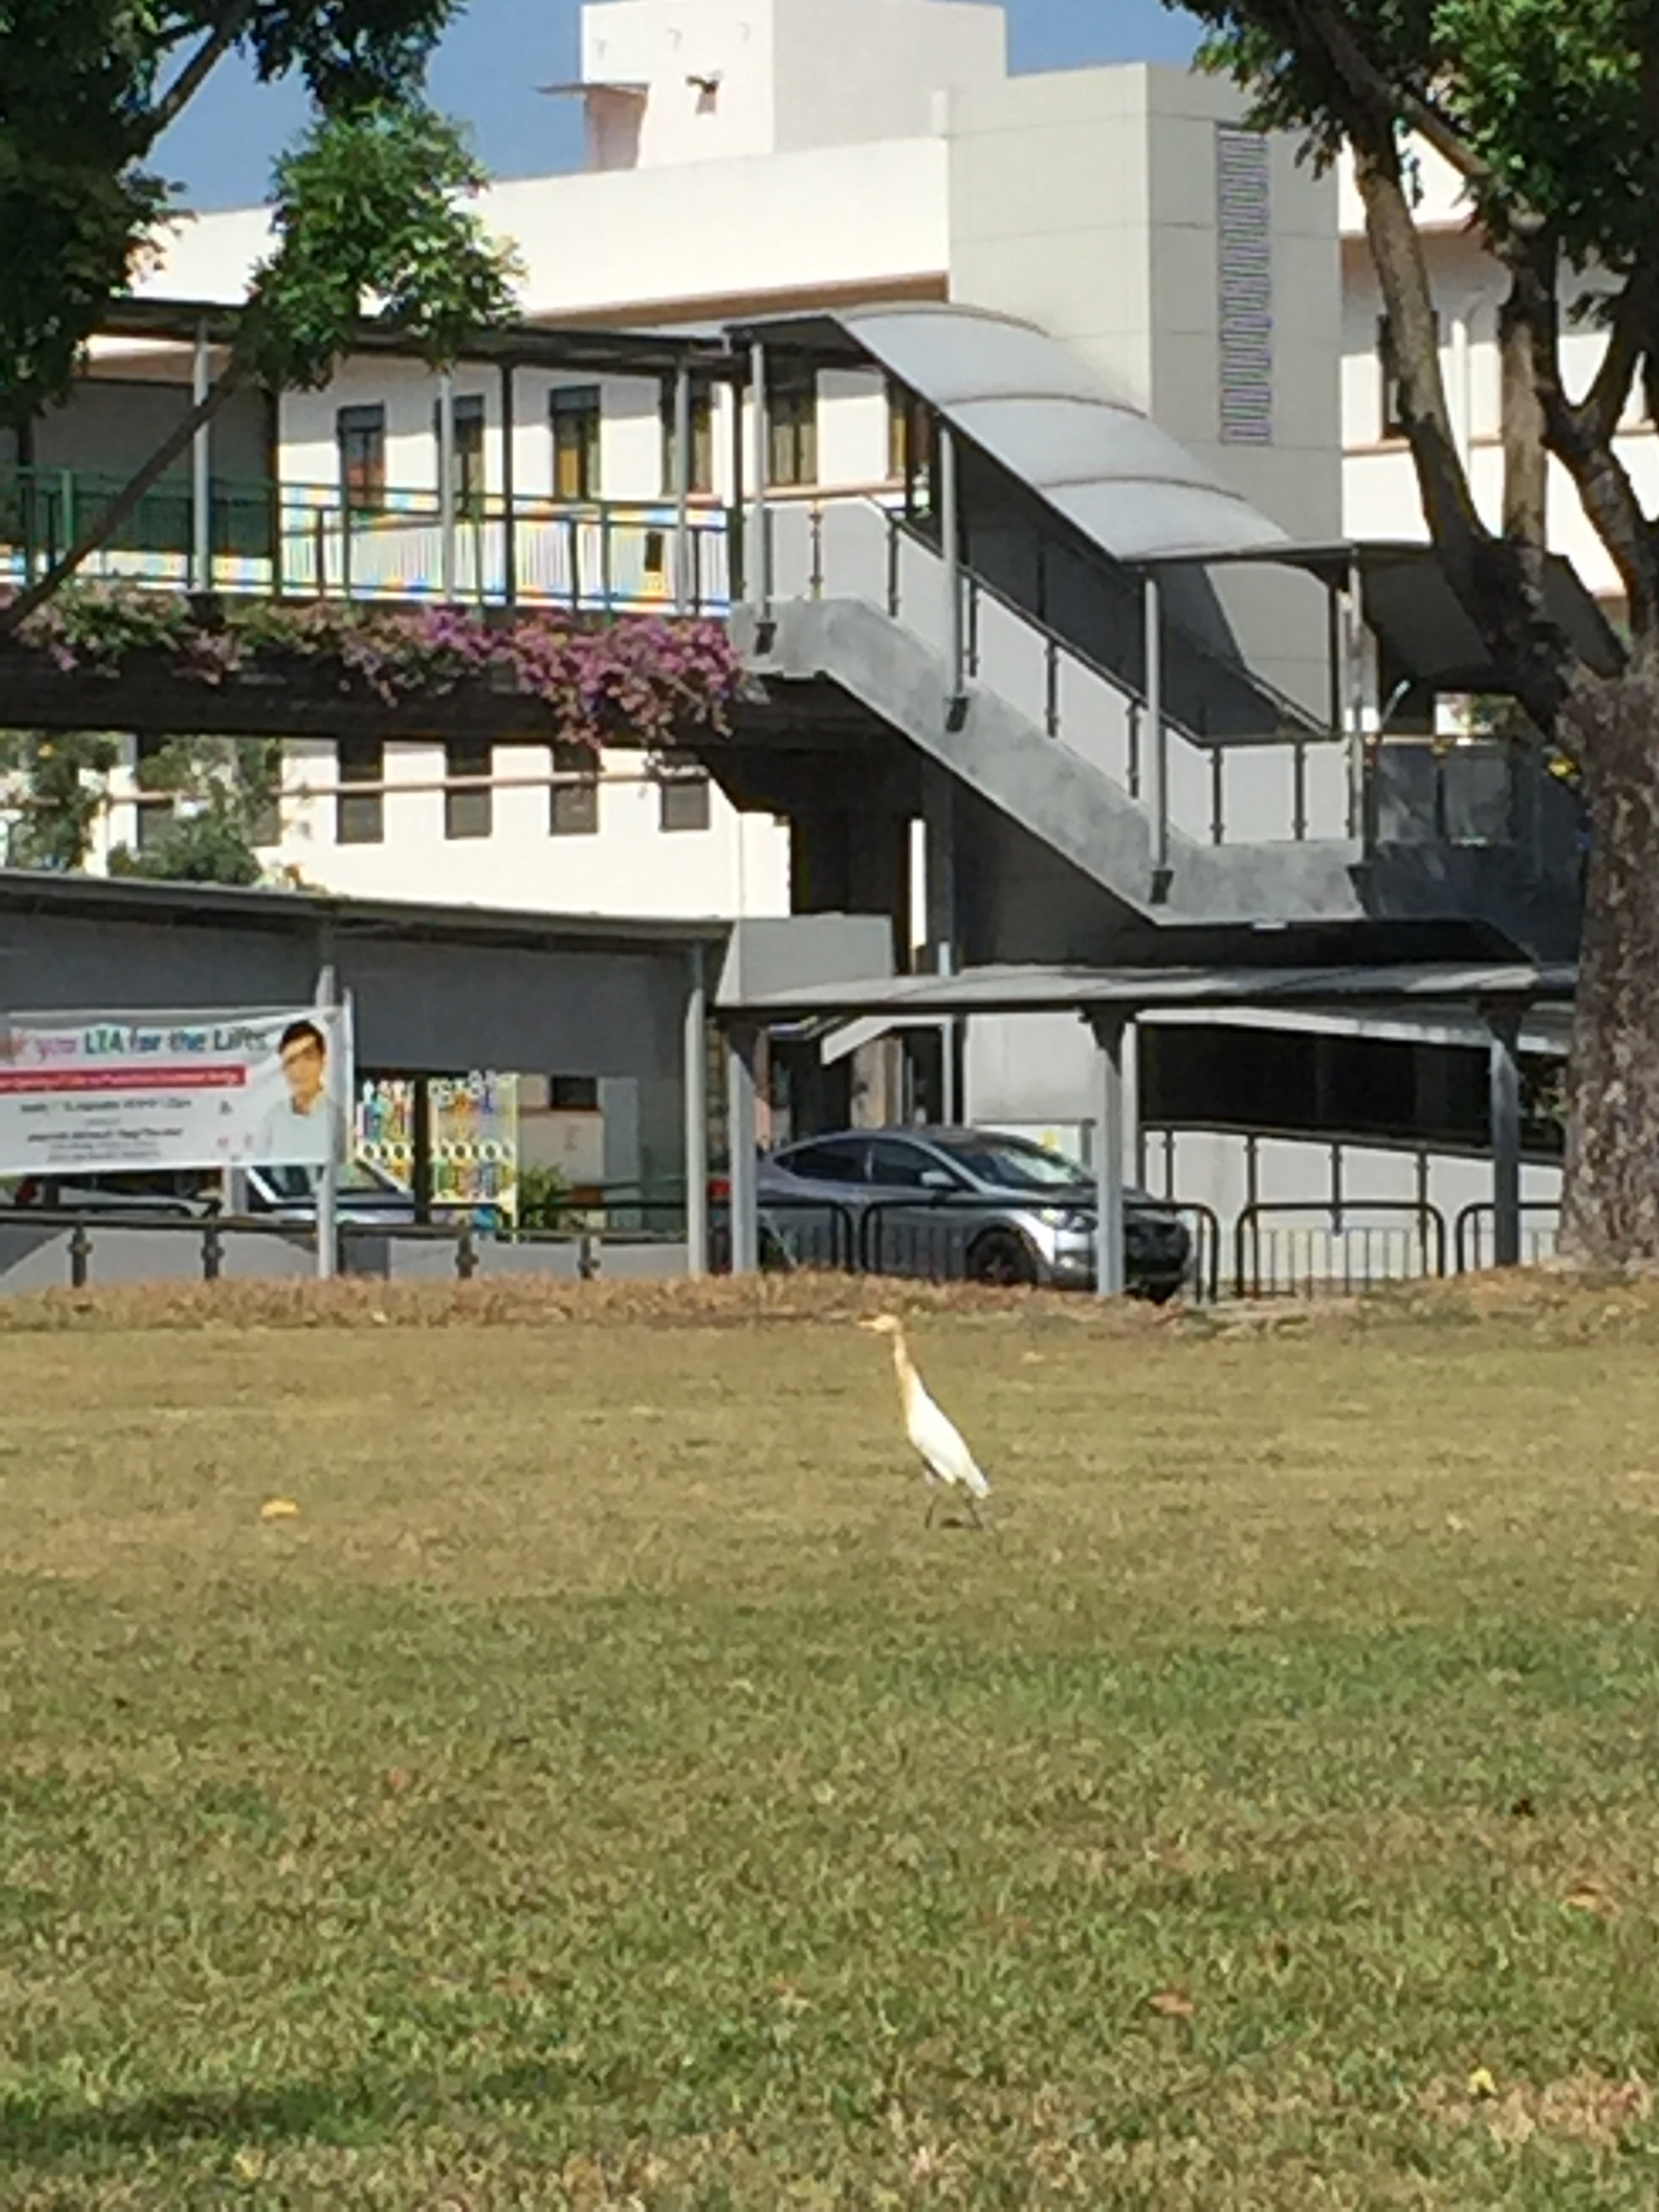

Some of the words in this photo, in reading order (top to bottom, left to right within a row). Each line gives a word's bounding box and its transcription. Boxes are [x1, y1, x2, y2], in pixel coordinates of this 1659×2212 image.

[85, 1029, 124, 1054] LTA
[129, 1025, 161, 1052] for
[170, 1028, 207, 1052] the
